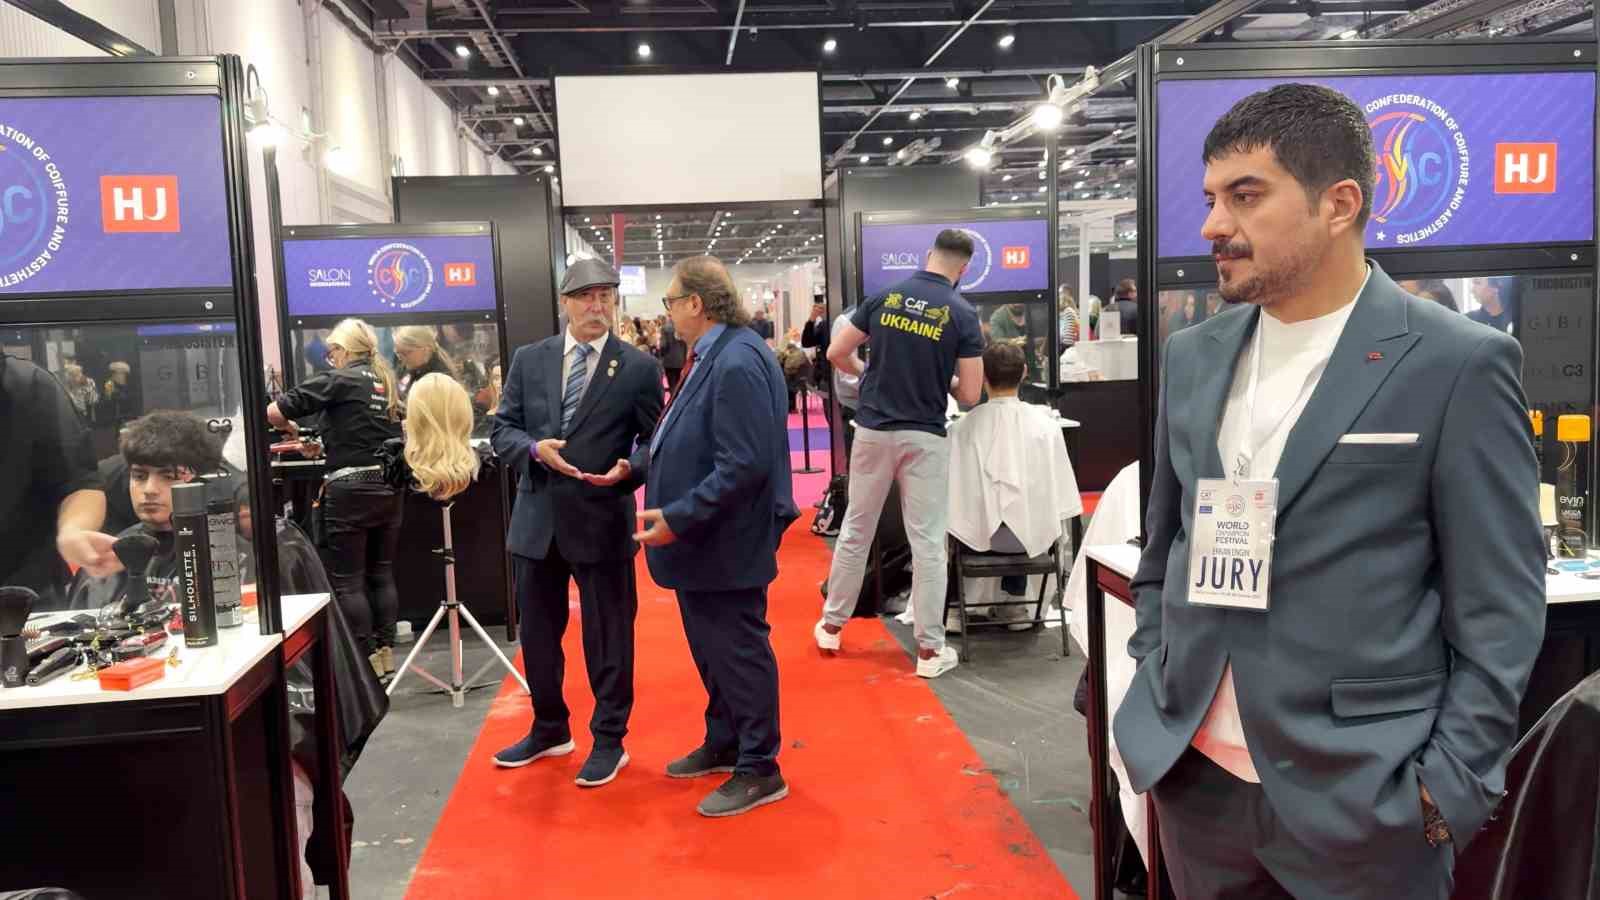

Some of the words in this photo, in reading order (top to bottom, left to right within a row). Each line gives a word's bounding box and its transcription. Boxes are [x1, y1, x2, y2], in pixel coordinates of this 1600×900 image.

[1366, 94, 1448, 121] CONFEDERATION
[1445, 117, 1458, 132] OF
[32, 146, 50, 162] OF
[1454, 132, 1469, 186] COIFFURE
[1503, 152, 1548, 184] HJ
[45, 162, 69, 224] COIFFURE
[112, 187, 168, 221] HJ
[1450, 186, 1464, 210] AND
[47, 224, 66, 251] AND
[1396, 208, 1453, 244] AESTHETICS
[881, 252, 920, 265] SALON
[1005, 251, 1026, 264] HJ
[308, 269, 351, 281] SALON
[448, 268, 471, 282] HJ
[905, 297, 928, 312] CAT
[880, 313, 943, 341] UKRAINE
[1562, 364, 1584, 377] C3
[1216, 521, 1249, 530] WORLD
[184, 551, 197, 622] SILHOUETTE
[1196, 557, 1263, 591] JURY
